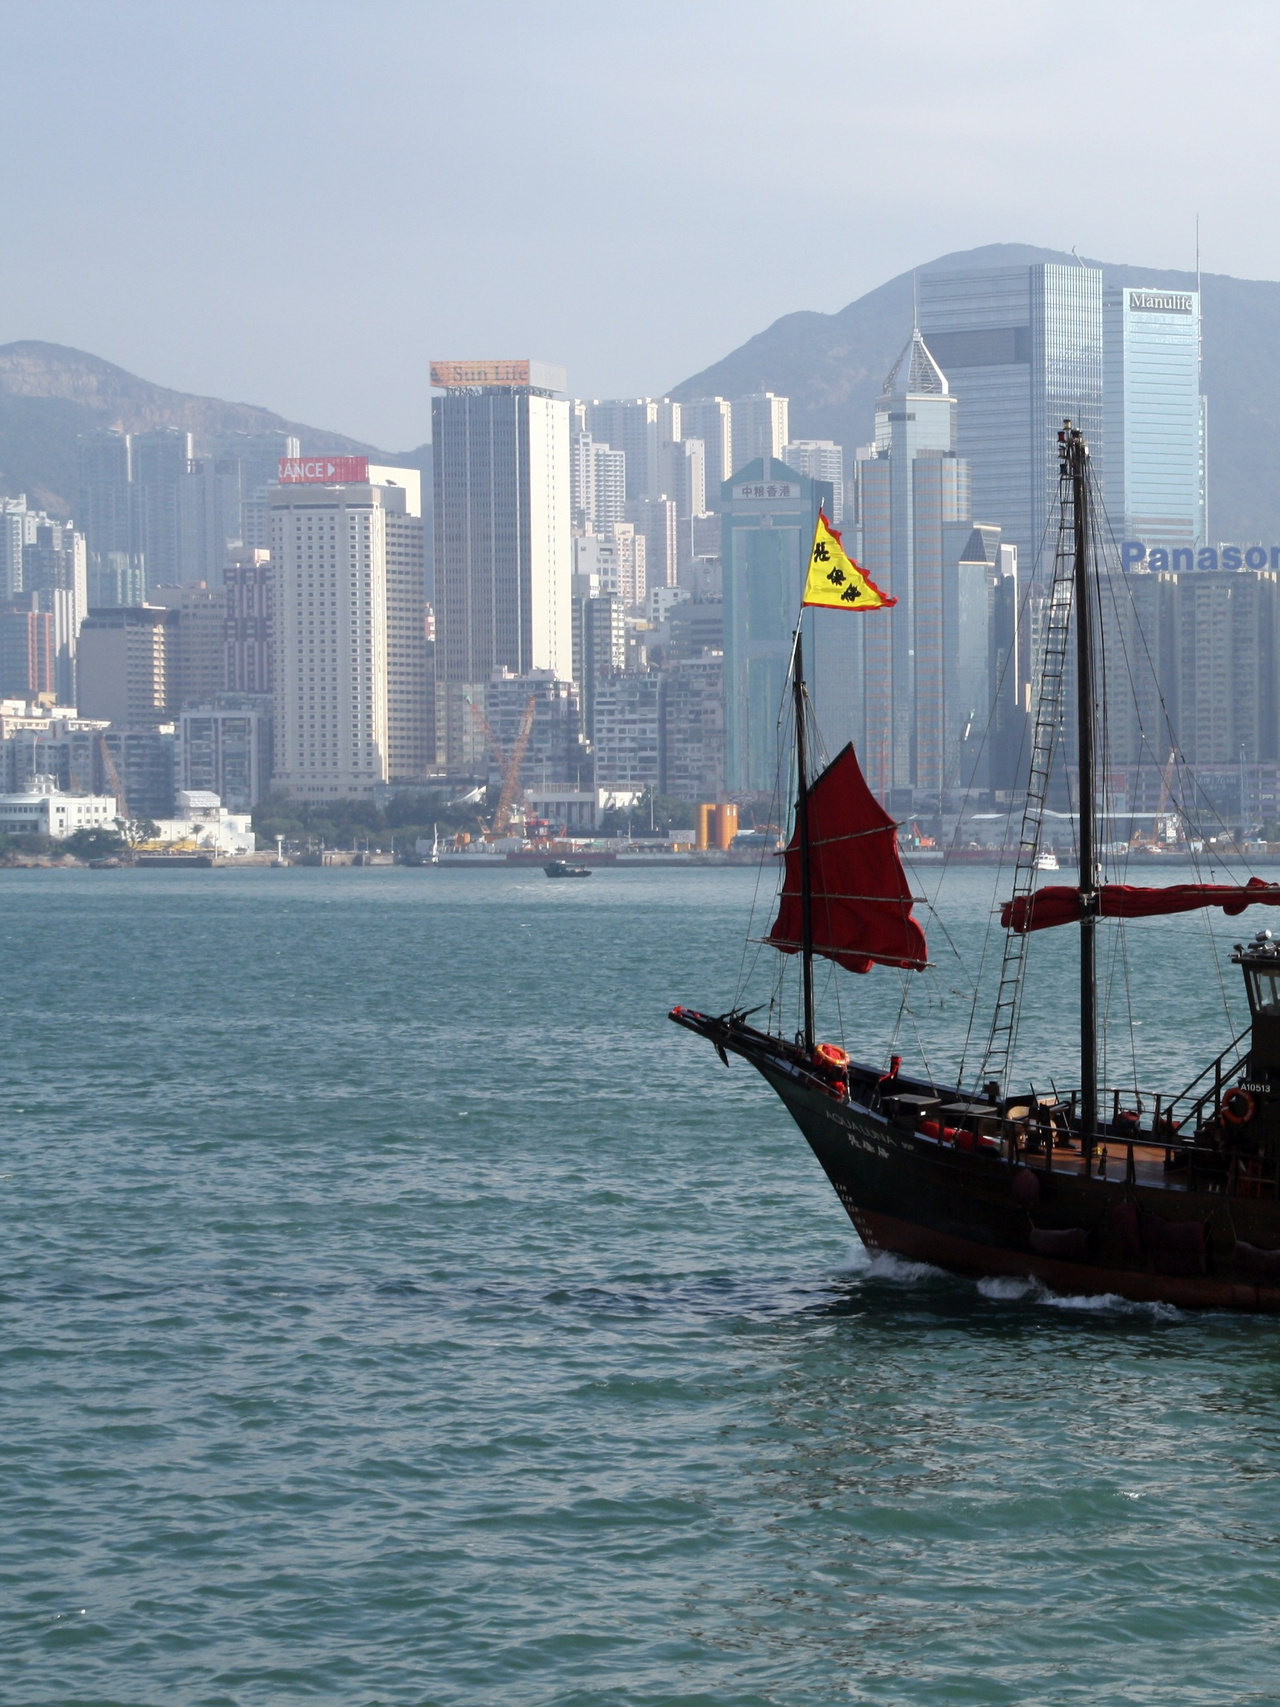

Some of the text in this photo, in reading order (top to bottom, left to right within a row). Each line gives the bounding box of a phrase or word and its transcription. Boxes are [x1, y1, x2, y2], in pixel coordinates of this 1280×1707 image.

[1130, 292, 1194, 310] Manulife
[453, 364, 529, 382] Sun Life
[742, 485, 791, 498] 中粮香港
[1240, 1082, 1271, 1093] A10513
